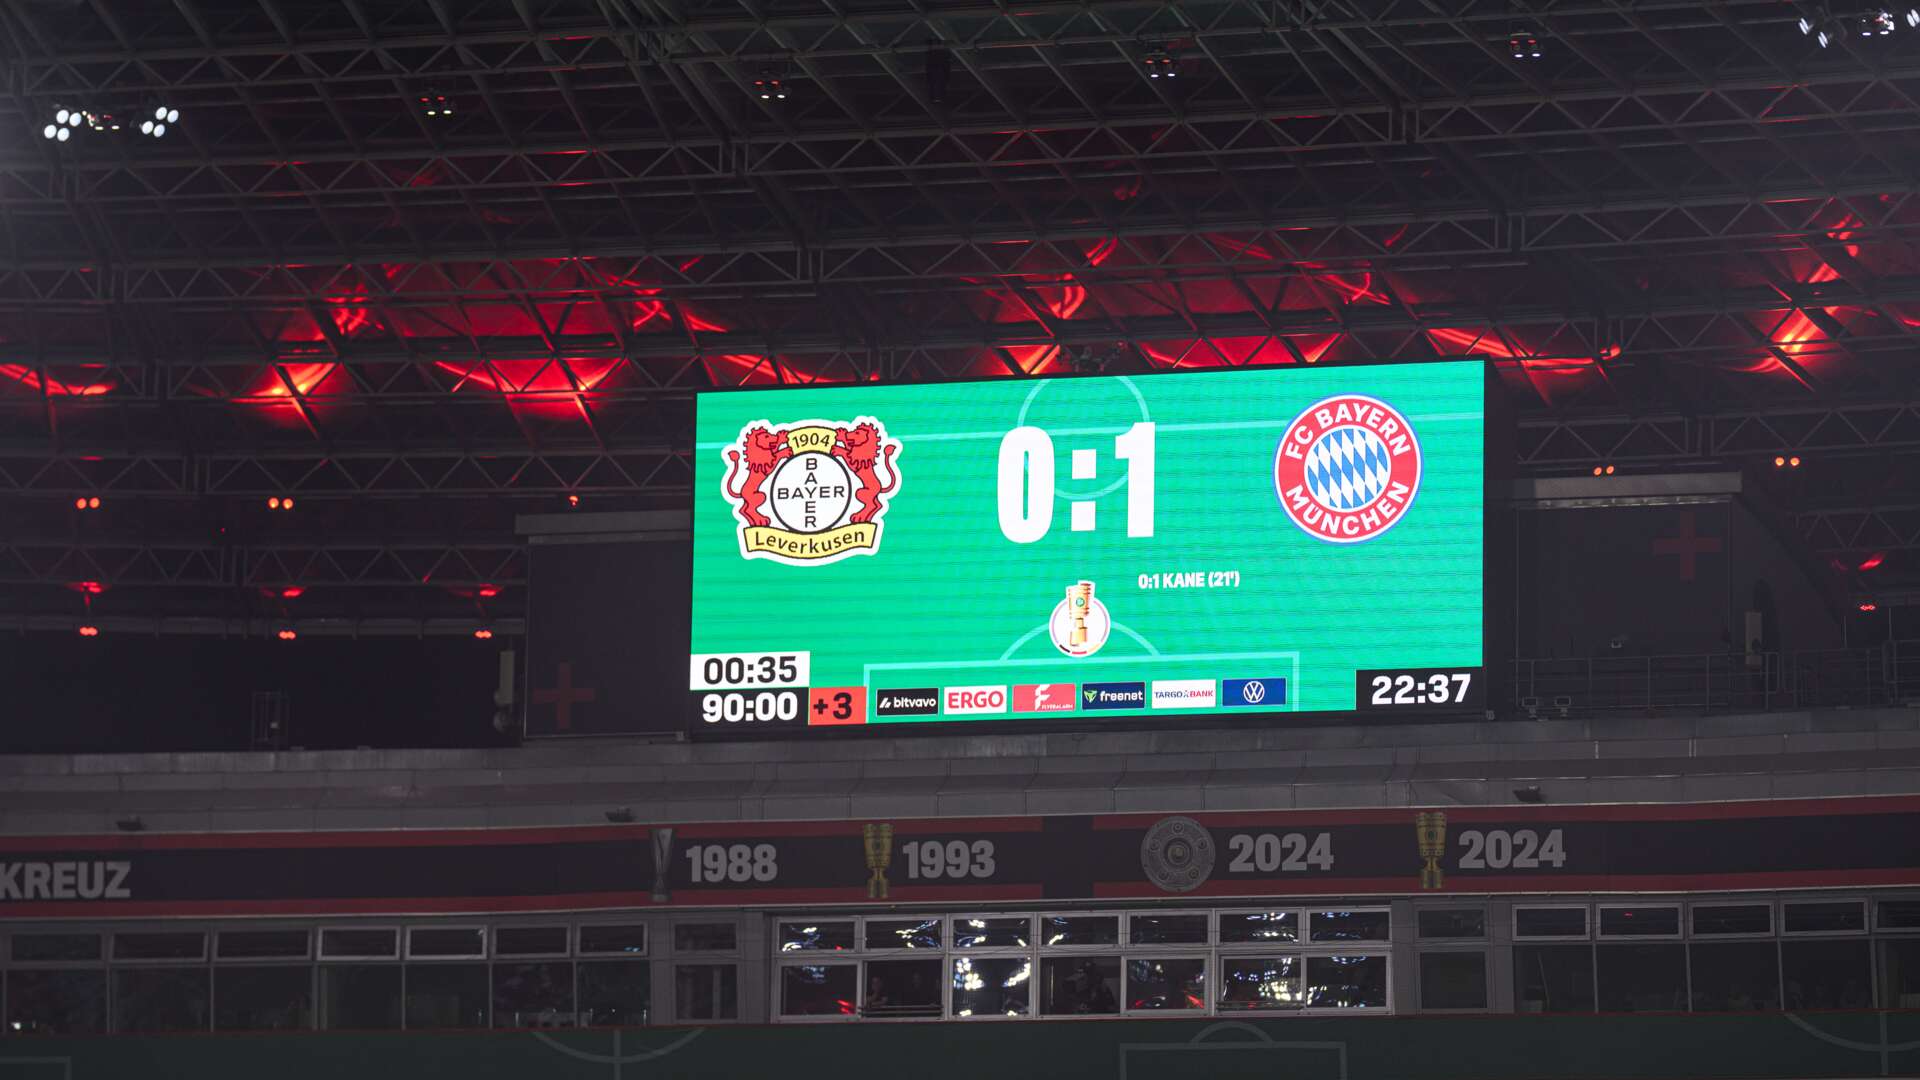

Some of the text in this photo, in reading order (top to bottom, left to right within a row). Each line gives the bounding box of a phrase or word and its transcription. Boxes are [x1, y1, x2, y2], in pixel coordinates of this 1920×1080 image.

[792, 432, 830, 449] 1904
[1285, 403, 1411, 460] FC BAYERN
[777, 486, 845, 500] BAYER
[997, 421, 1156, 543] 0:1
[1286, 481, 1409, 535] MÜNCHEN
[755, 531, 865, 554] Leverkusen
[1138, 570, 1240, 589] 0:1 KANE (21')
[704, 656, 797, 685] 00:35
[893, 697, 937, 708] bitvavo
[947, 691, 1004, 709] ERGO
[1100, 690, 1143, 701] freenet
[1372, 674, 1471, 705] 22:37
[702, 692, 853, 722] 90:00 +3
[686, 844, 778, 883] 1988
[903, 840, 995, 879] 1993
[1228, 833, 1334, 872] 2024
[1458, 829, 1566, 868] 2024
